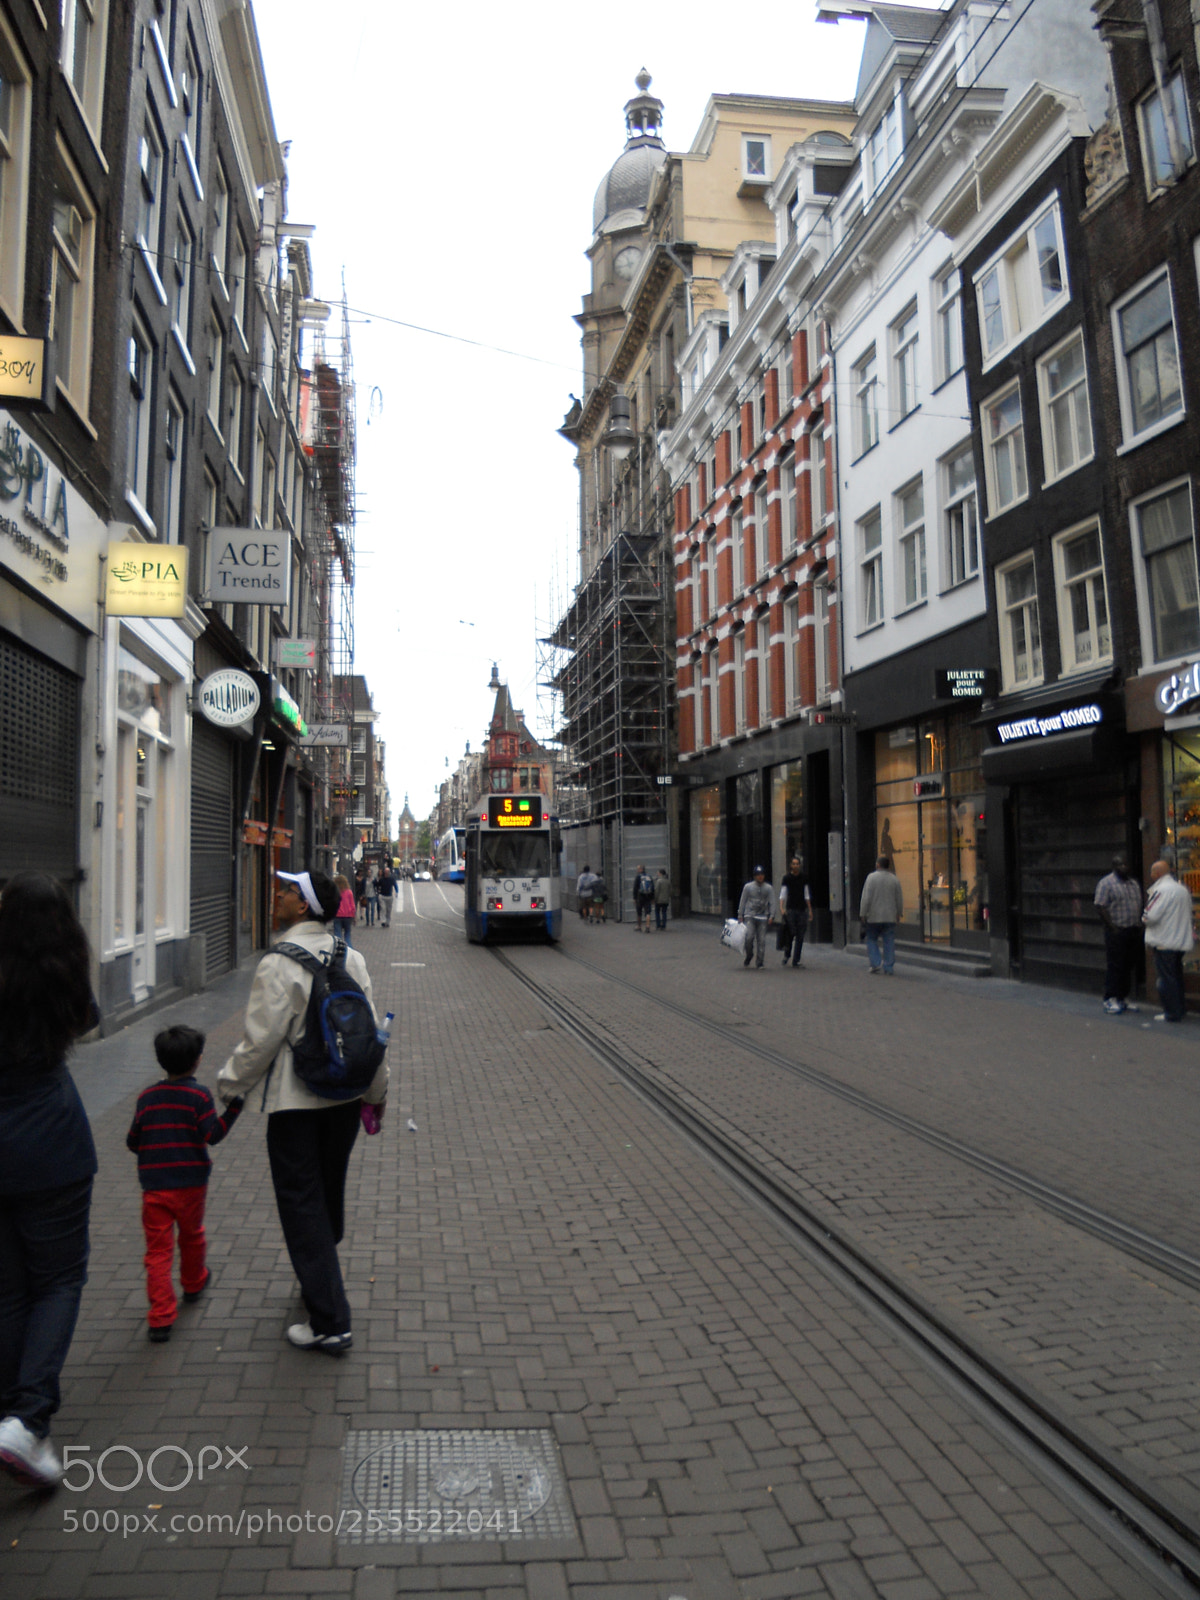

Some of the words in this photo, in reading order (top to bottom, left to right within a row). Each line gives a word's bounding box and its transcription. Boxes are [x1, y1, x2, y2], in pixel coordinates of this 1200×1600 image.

[218, 542, 281, 568] ACE
[141, 562, 180, 581] PIA
[218, 571, 281, 589] Trends
[946, 670, 985, 681] JULIETTE
[956, 679, 976, 688] pour
[203, 682, 256, 714] PALLADIUM
[952, 687, 982, 697] ROMEO
[998, 717, 1040, 743] JULIETTE
[1039, 716, 1063, 736] pour
[1062, 704, 1102, 728] ROMEO
[657, 774, 673, 784] WE
[504, 798, 513, 813] 5
